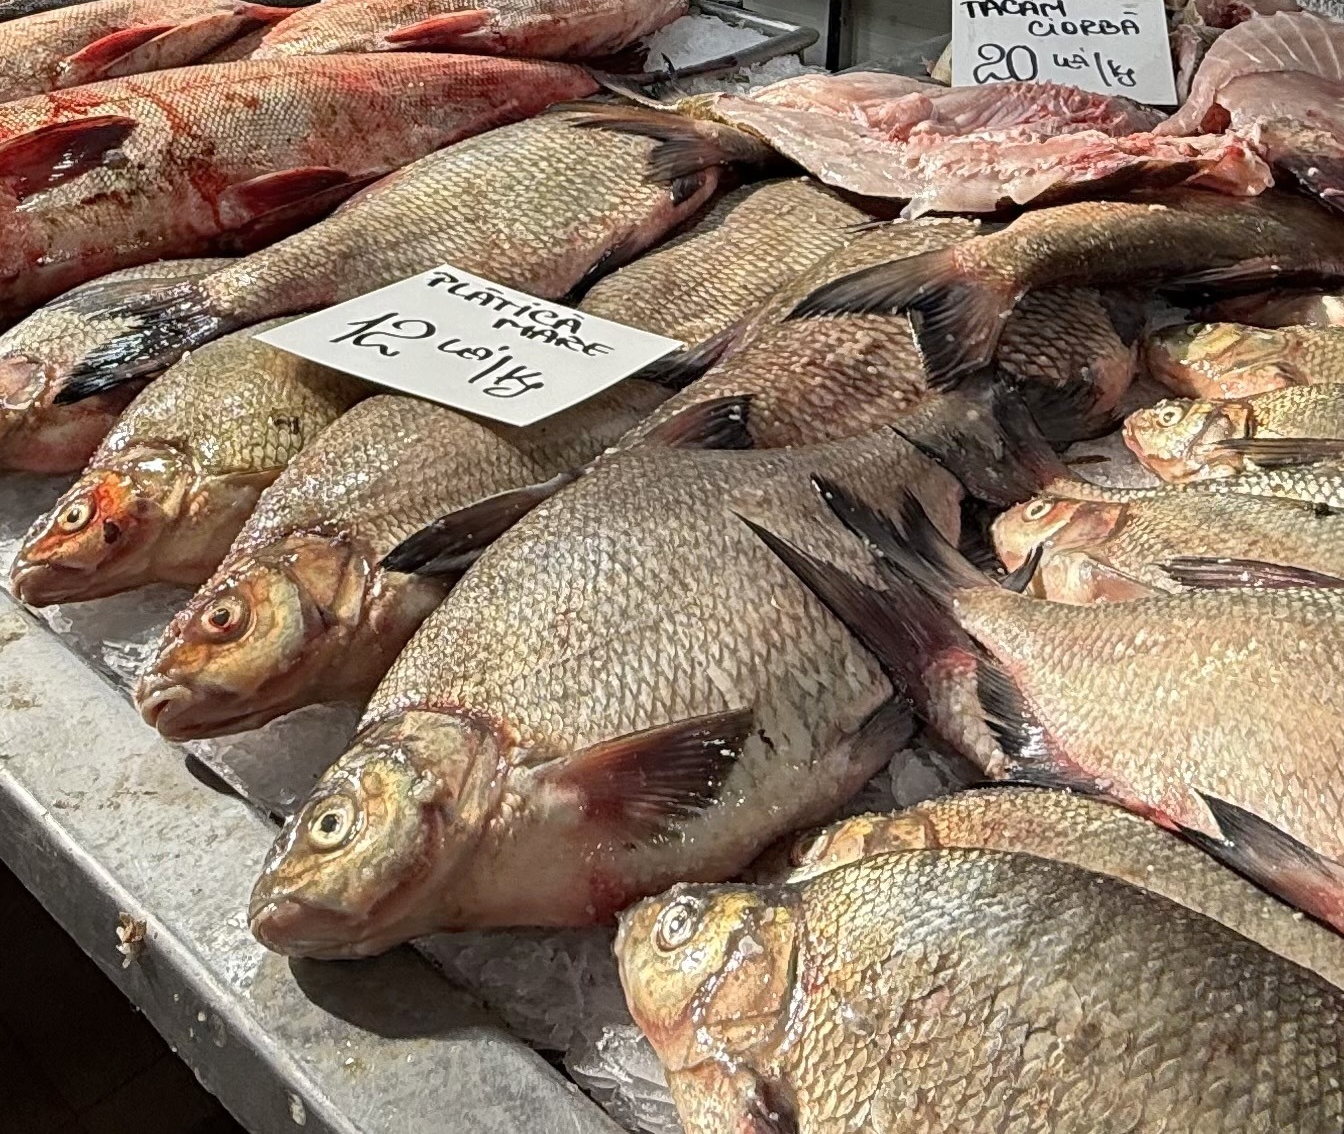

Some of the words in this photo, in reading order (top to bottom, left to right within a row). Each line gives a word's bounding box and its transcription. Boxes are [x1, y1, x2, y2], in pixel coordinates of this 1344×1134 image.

[973, 43, 1038, 84] 20
[329, 312, 436, 357] 12
[493, 318, 616, 357] MARE
